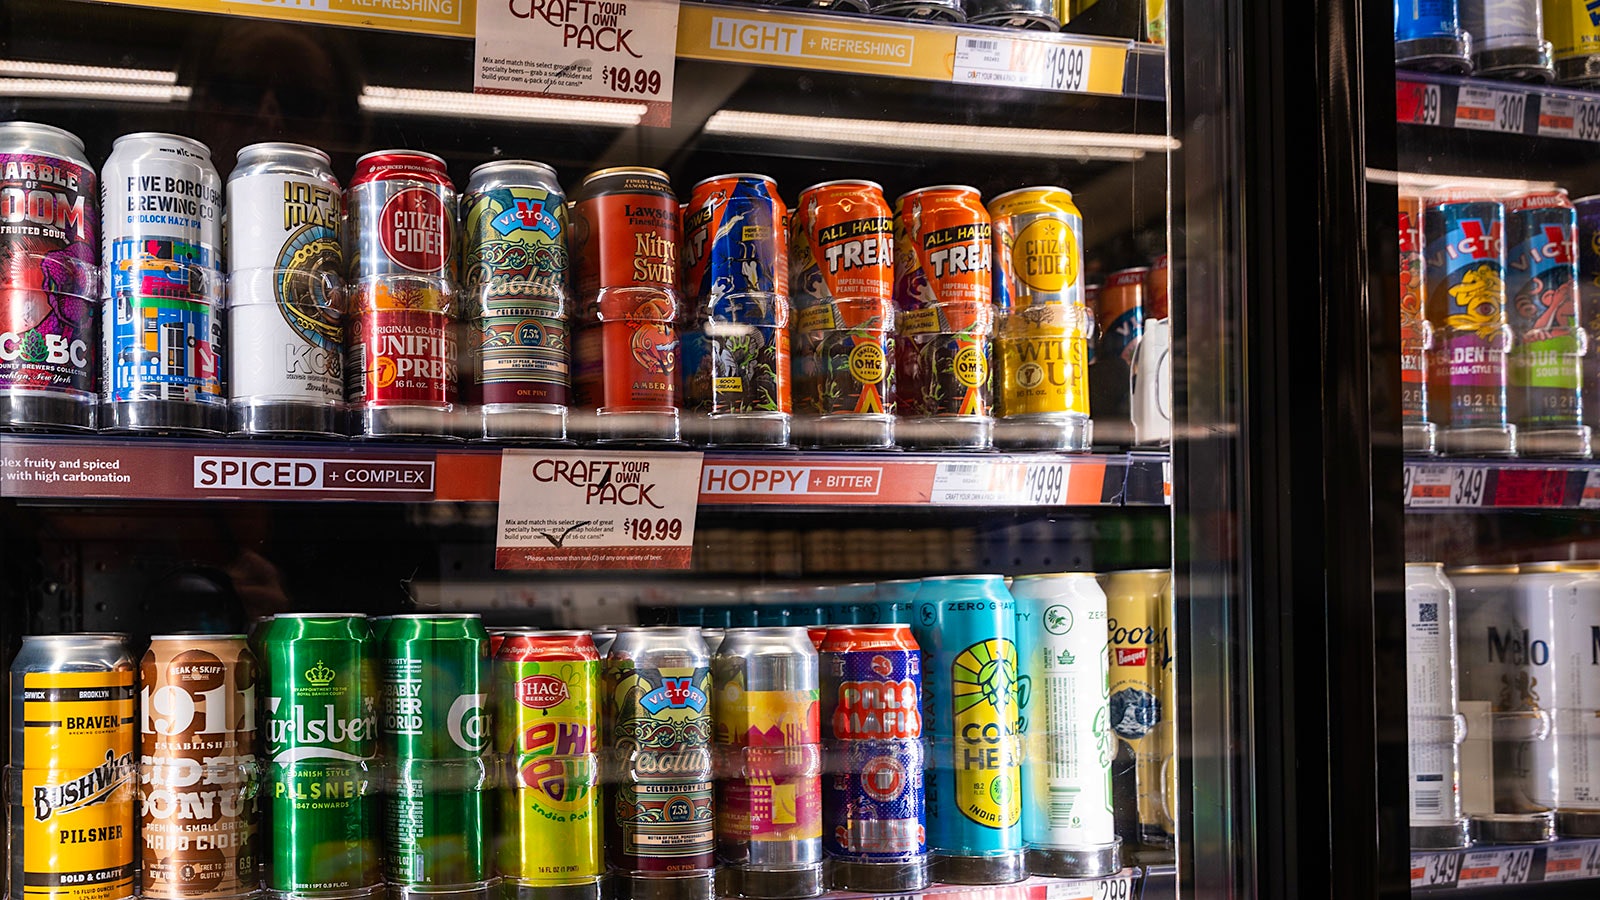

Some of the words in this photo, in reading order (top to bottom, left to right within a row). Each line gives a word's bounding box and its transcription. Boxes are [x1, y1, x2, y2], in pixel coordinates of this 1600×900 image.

[600, 2, 626, 16] YOUR
[593, 14, 617, 27] OWN
[563, 23, 643, 58] PACK
[716, 22, 797, 53] LIGHT
[821, 37, 906, 58] REFRESHING
[536, 61, 552, 69] select
[602, 65, 662, 95] $19.99
[0, 162, 79, 192] ARBLE
[128, 176, 161, 192] FIVE
[26, 181, 39, 190] OF
[128, 195, 197, 216] BREWING
[168, 216, 189, 226] HAZY
[191, 221, 202, 230] IPA
[394, 211, 443, 230] CITIZEN
[500, 209, 557, 231] VICTORY
[1, 225, 40, 236] FRUITED
[43, 228, 67, 241] SOUR
[821, 227, 847, 243] ALL
[925, 230, 952, 247] ALL
[394, 229, 443, 256] CIDER
[1025, 240, 1071, 256] CITIZEN
[633, 257, 676, 285] Swir
[1026, 255, 1071, 276] CIDER
[371, 325, 414, 334] ORIGINAL
[370, 335, 458, 361] UNIFIED
[22, 363, 55, 371] BREWERS
[396, 358, 459, 383] PRESS
[1536, 367, 1560, 378] SOUR
[53, 373, 72, 384] York
[395, 380, 405, 388] 16
[406, 380, 414, 388] fl.
[633, 382, 666, 390] AMBER
[1457, 395, 1482, 408] 19.2
[1485, 395, 1498, 406] FL
[24, 458, 56, 470] fruity
[59, 459, 80, 469] and
[83, 459, 120, 472] spiced
[532, 459, 620, 487] CRAFT
[621, 461, 650, 473] YOUR
[6, 471, 32, 481] with
[35, 471, 60, 483] high
[63, 472, 131, 483] carbonation
[200, 461, 317, 486] SPICED
[344, 470, 425, 484] COMPLEX
[616, 472, 640, 484] OWN
[707, 468, 804, 492] HOPPY
[826, 476, 873, 488] BITTER
[586, 483, 664, 509] PACK
[624, 518, 682, 541] $19.99
[948, 602, 984, 611] ZERO
[1118, 650, 1146, 665] Banquet
[199, 666, 220, 674] SKIFF
[79, 690, 110, 699] BROOKLYN
[649, 688, 703, 706] VICTORY
[844, 688, 914, 710] PILLS
[386, 698, 422, 714] BEER
[839, 710, 919, 733] MAFIA
[155, 740, 239, 751] ESTABLISHED
[291, 769, 322, 778] DANISH
[326, 769, 350, 777] STYLE
[646, 784, 696, 793] CELEBRATORY
[312, 801, 350, 810] ONWARDS
[531, 803, 566, 822] India
[970, 804, 996, 822] INDIA
[186, 823, 218, 832] SMALL
[222, 820, 248, 830] BATCH
[60, 825, 123, 844] PILSNER
[146, 834, 189, 851] HARD
[196, 832, 248, 850] CIDER
[60, 875, 85, 883] BOLD
[96, 869, 122, 880] CRAFTY
[200, 871, 220, 880] GLUTEN
